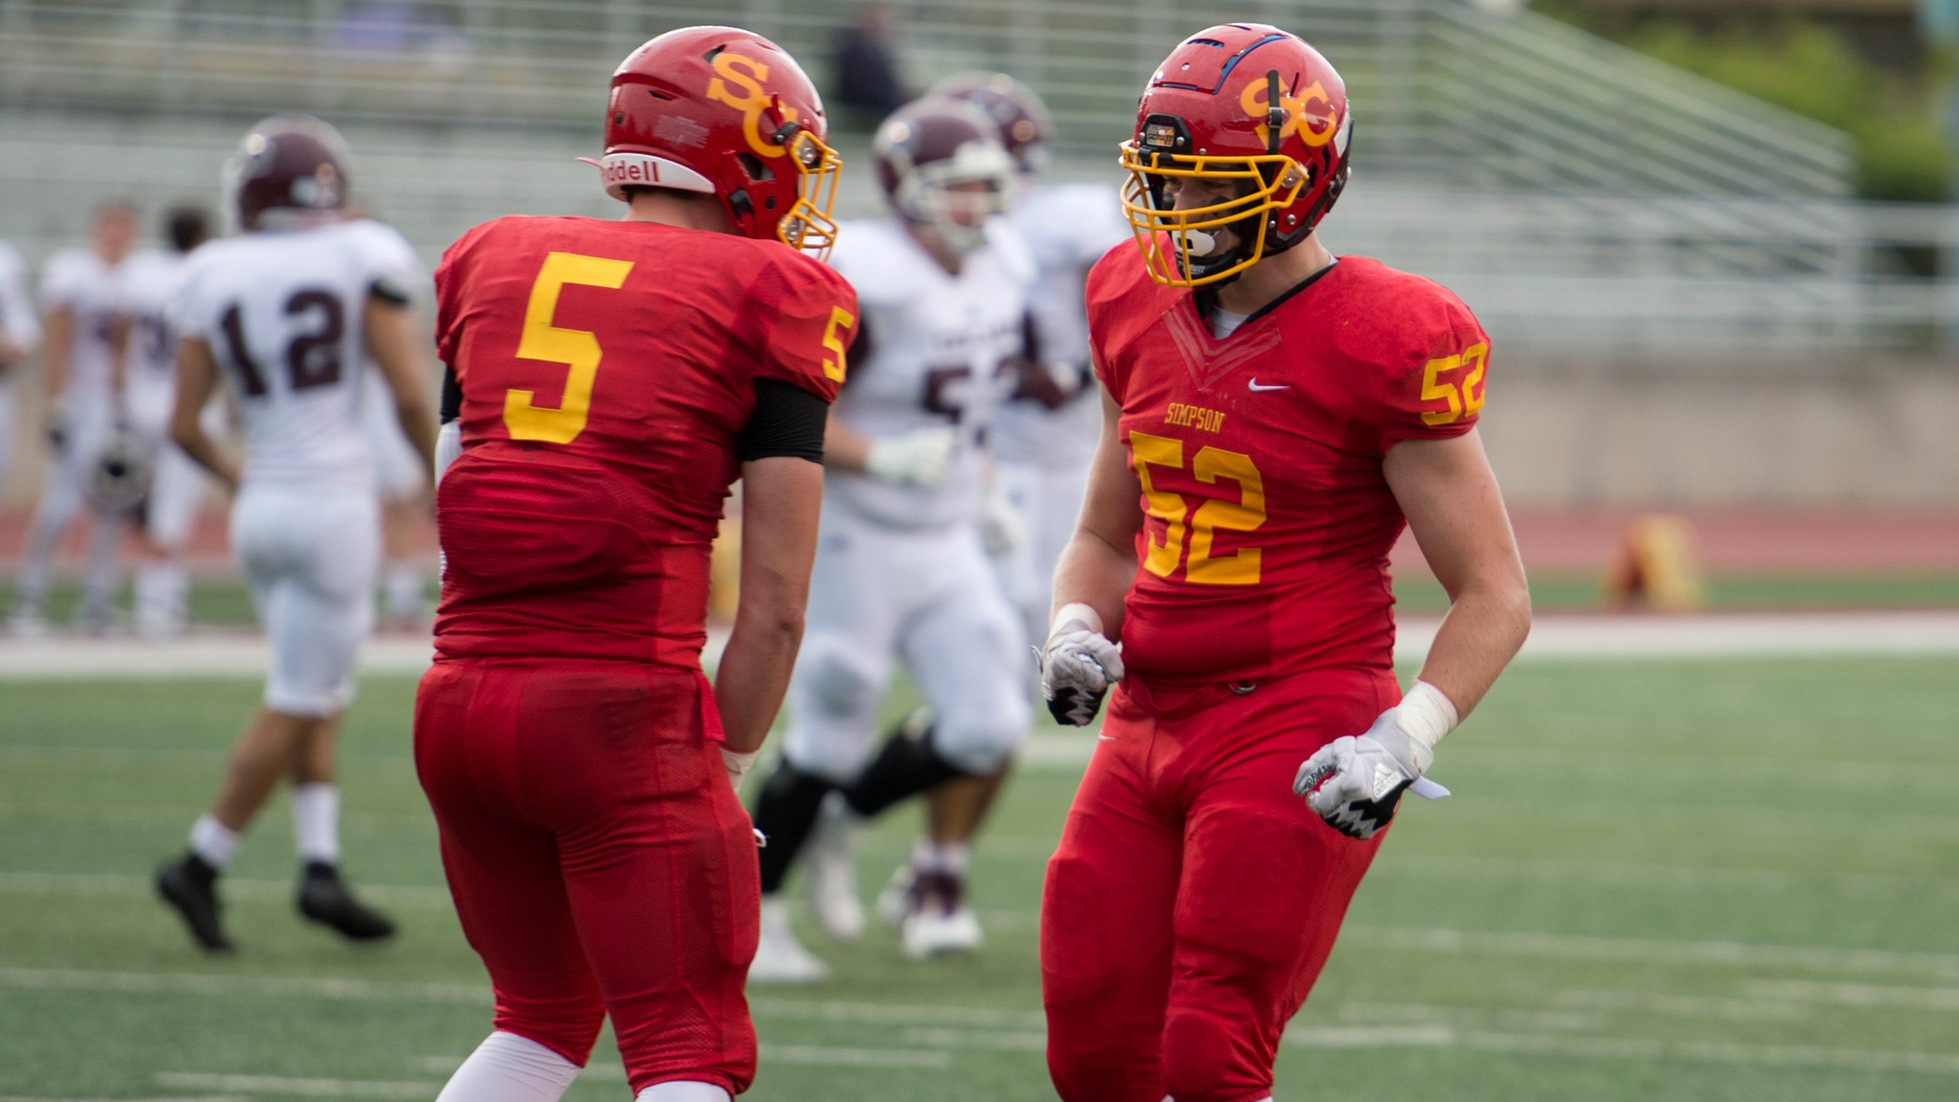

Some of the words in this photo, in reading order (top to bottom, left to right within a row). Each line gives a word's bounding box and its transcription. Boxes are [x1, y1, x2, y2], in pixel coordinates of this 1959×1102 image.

[221, 288, 345, 398] 12
[502, 251, 636, 445] 5
[822, 305, 855, 385] 5
[1420, 341, 1489, 427] 52
[1164, 402, 1226, 434] SIMPSON
[1129, 430, 1268, 586] 52
